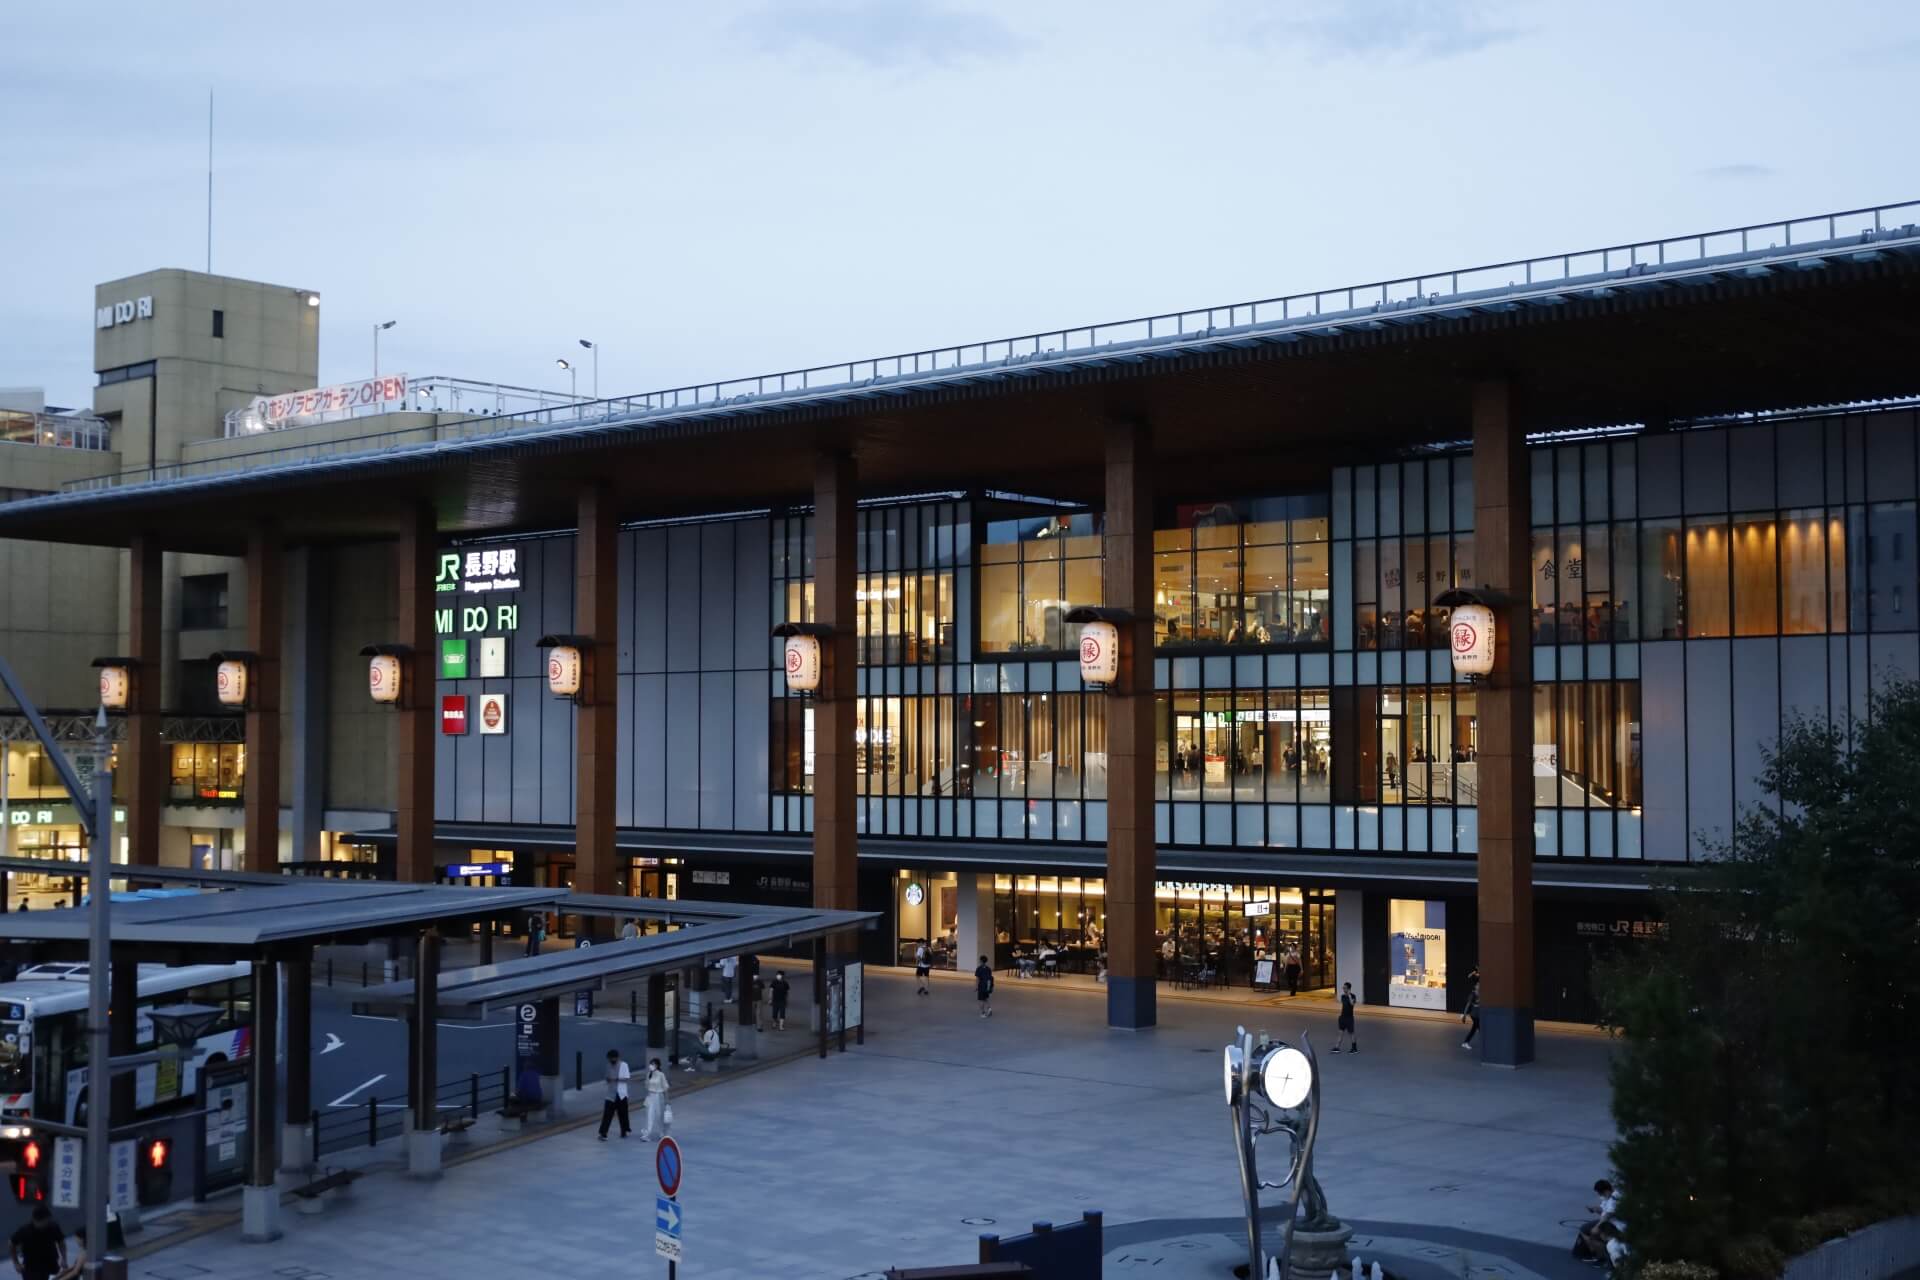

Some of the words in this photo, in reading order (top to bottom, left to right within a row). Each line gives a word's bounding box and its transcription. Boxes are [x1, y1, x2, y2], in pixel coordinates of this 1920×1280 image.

[361, 376, 405, 404] OPEN
[436, 553, 460, 582] JR
[465, 549, 516, 577] 長野駅
[1609, 920, 1630, 934] JR
